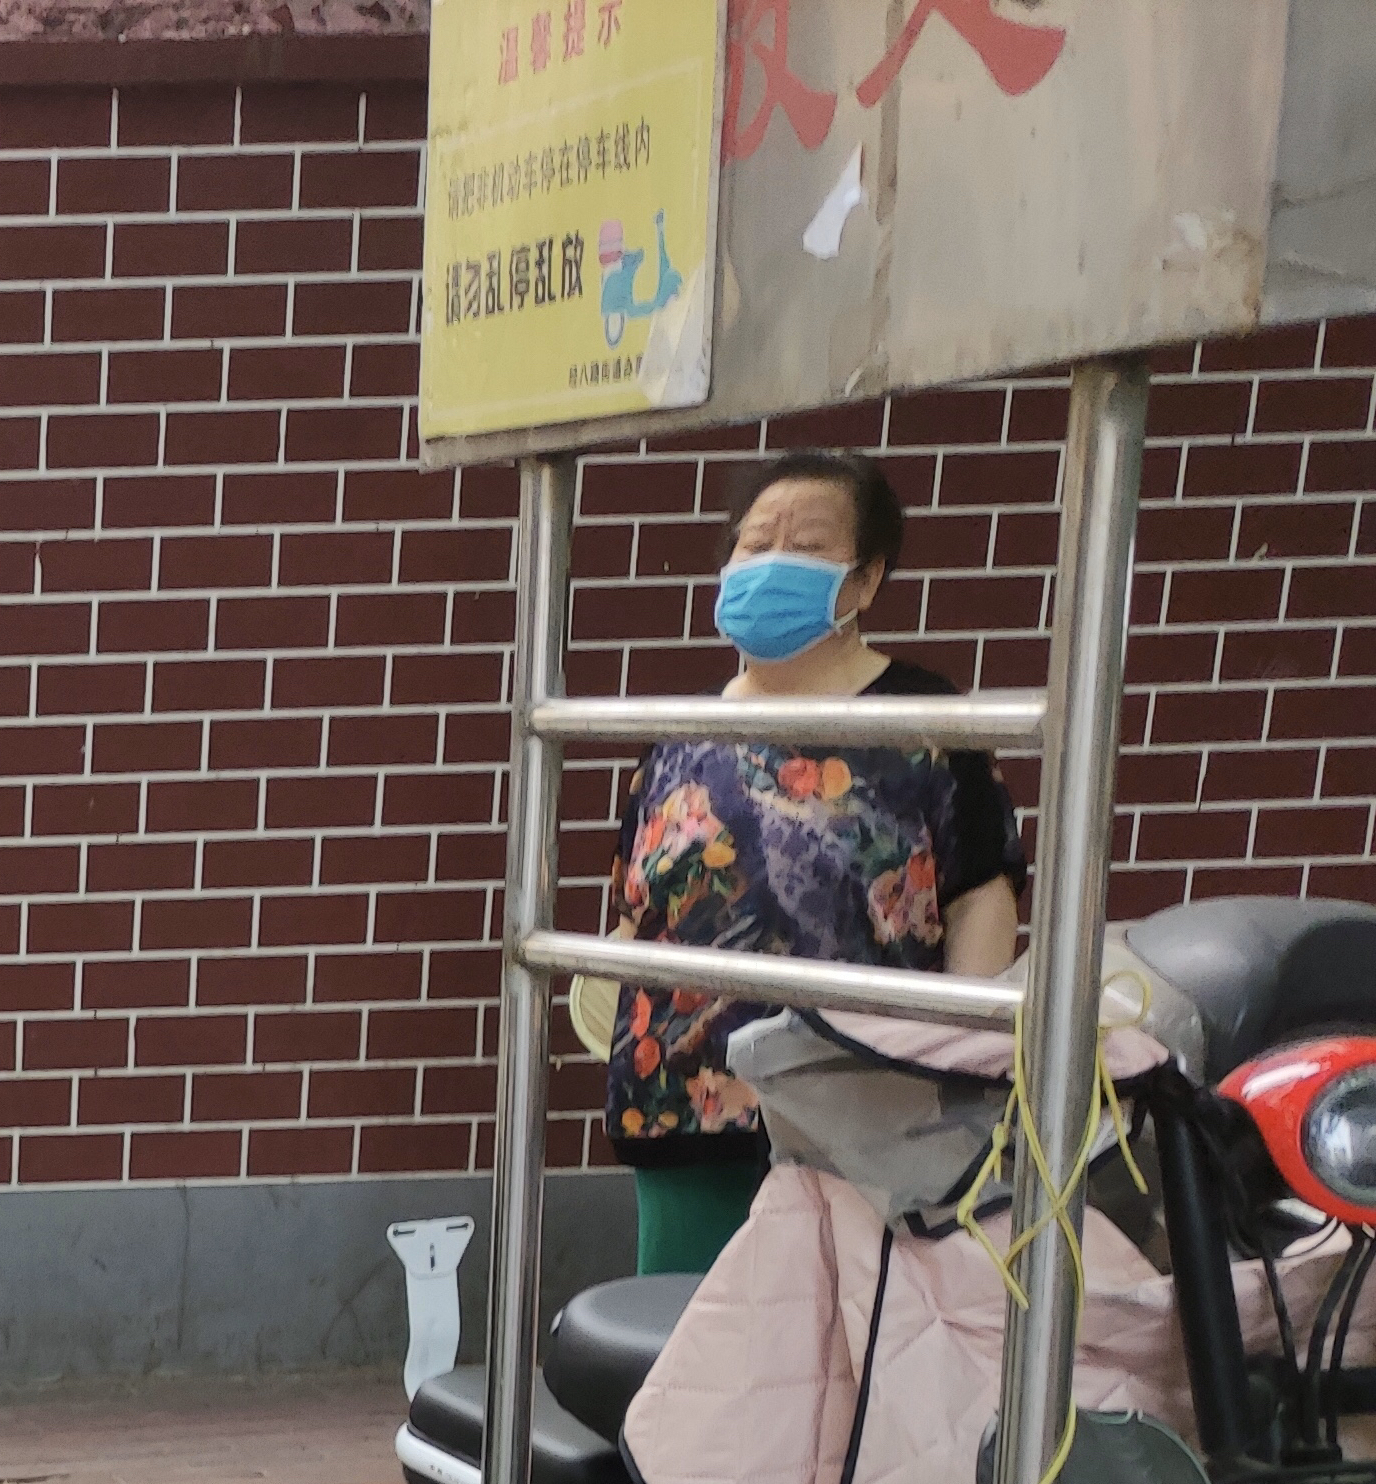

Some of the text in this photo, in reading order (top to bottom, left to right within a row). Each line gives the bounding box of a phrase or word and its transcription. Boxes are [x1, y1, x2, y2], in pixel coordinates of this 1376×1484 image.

[445, 229, 585, 327] 请勿乱停乱放
